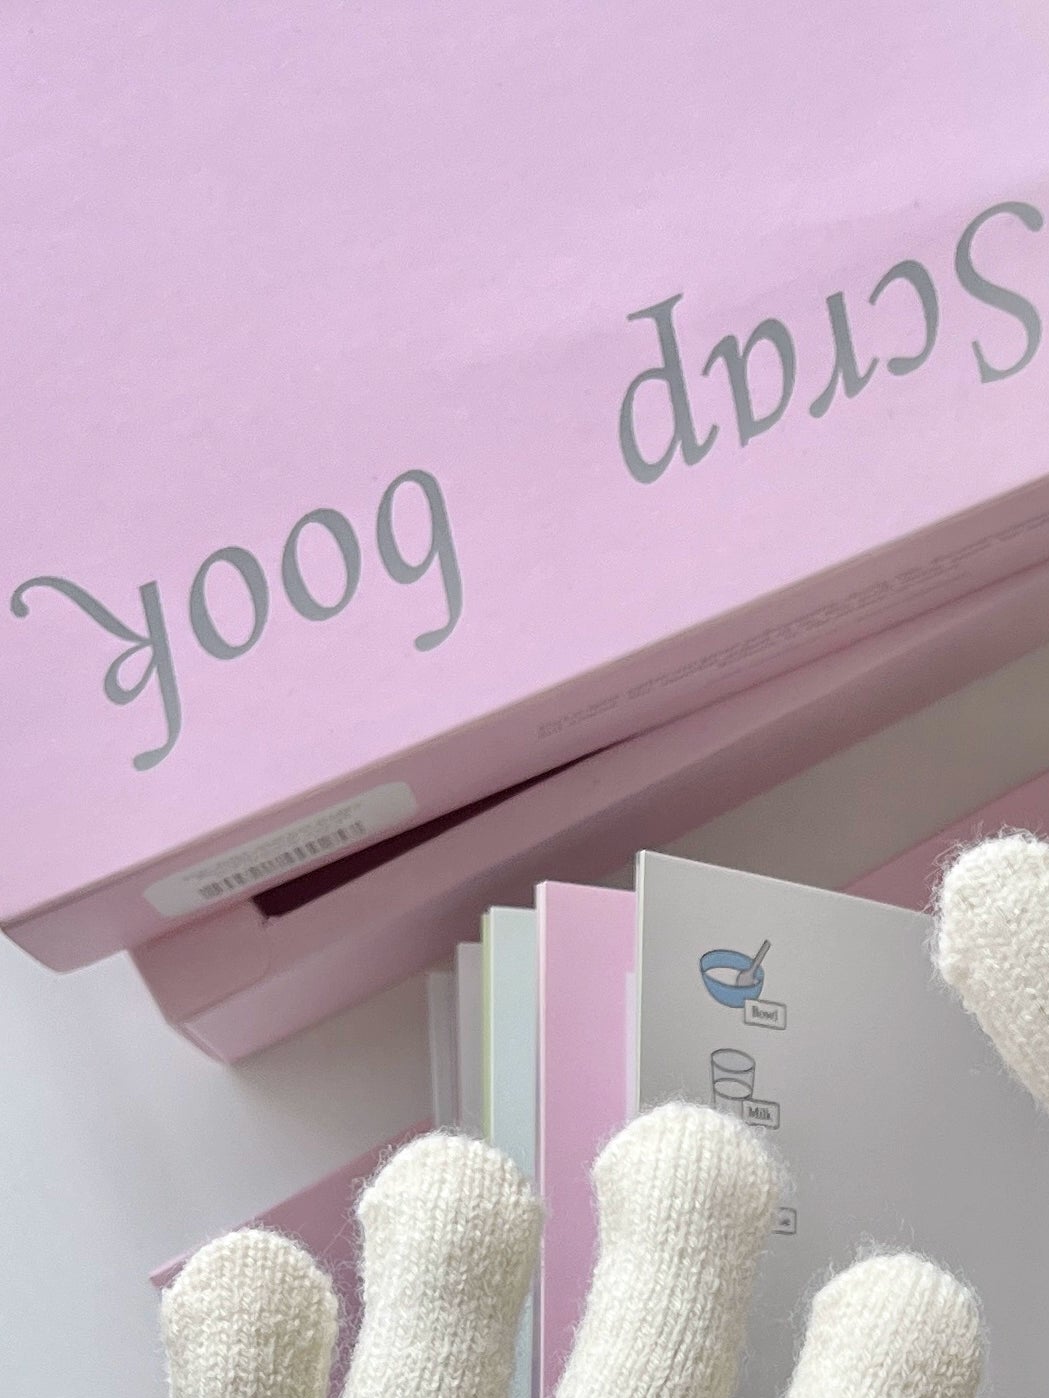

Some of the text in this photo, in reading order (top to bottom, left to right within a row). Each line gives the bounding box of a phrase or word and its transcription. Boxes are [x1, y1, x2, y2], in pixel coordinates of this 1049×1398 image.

[12, 203, 1043, 771] Scrap book
[752, 1005, 778, 1021] Bowl
[748, 1106, 772, 1121] Milk
